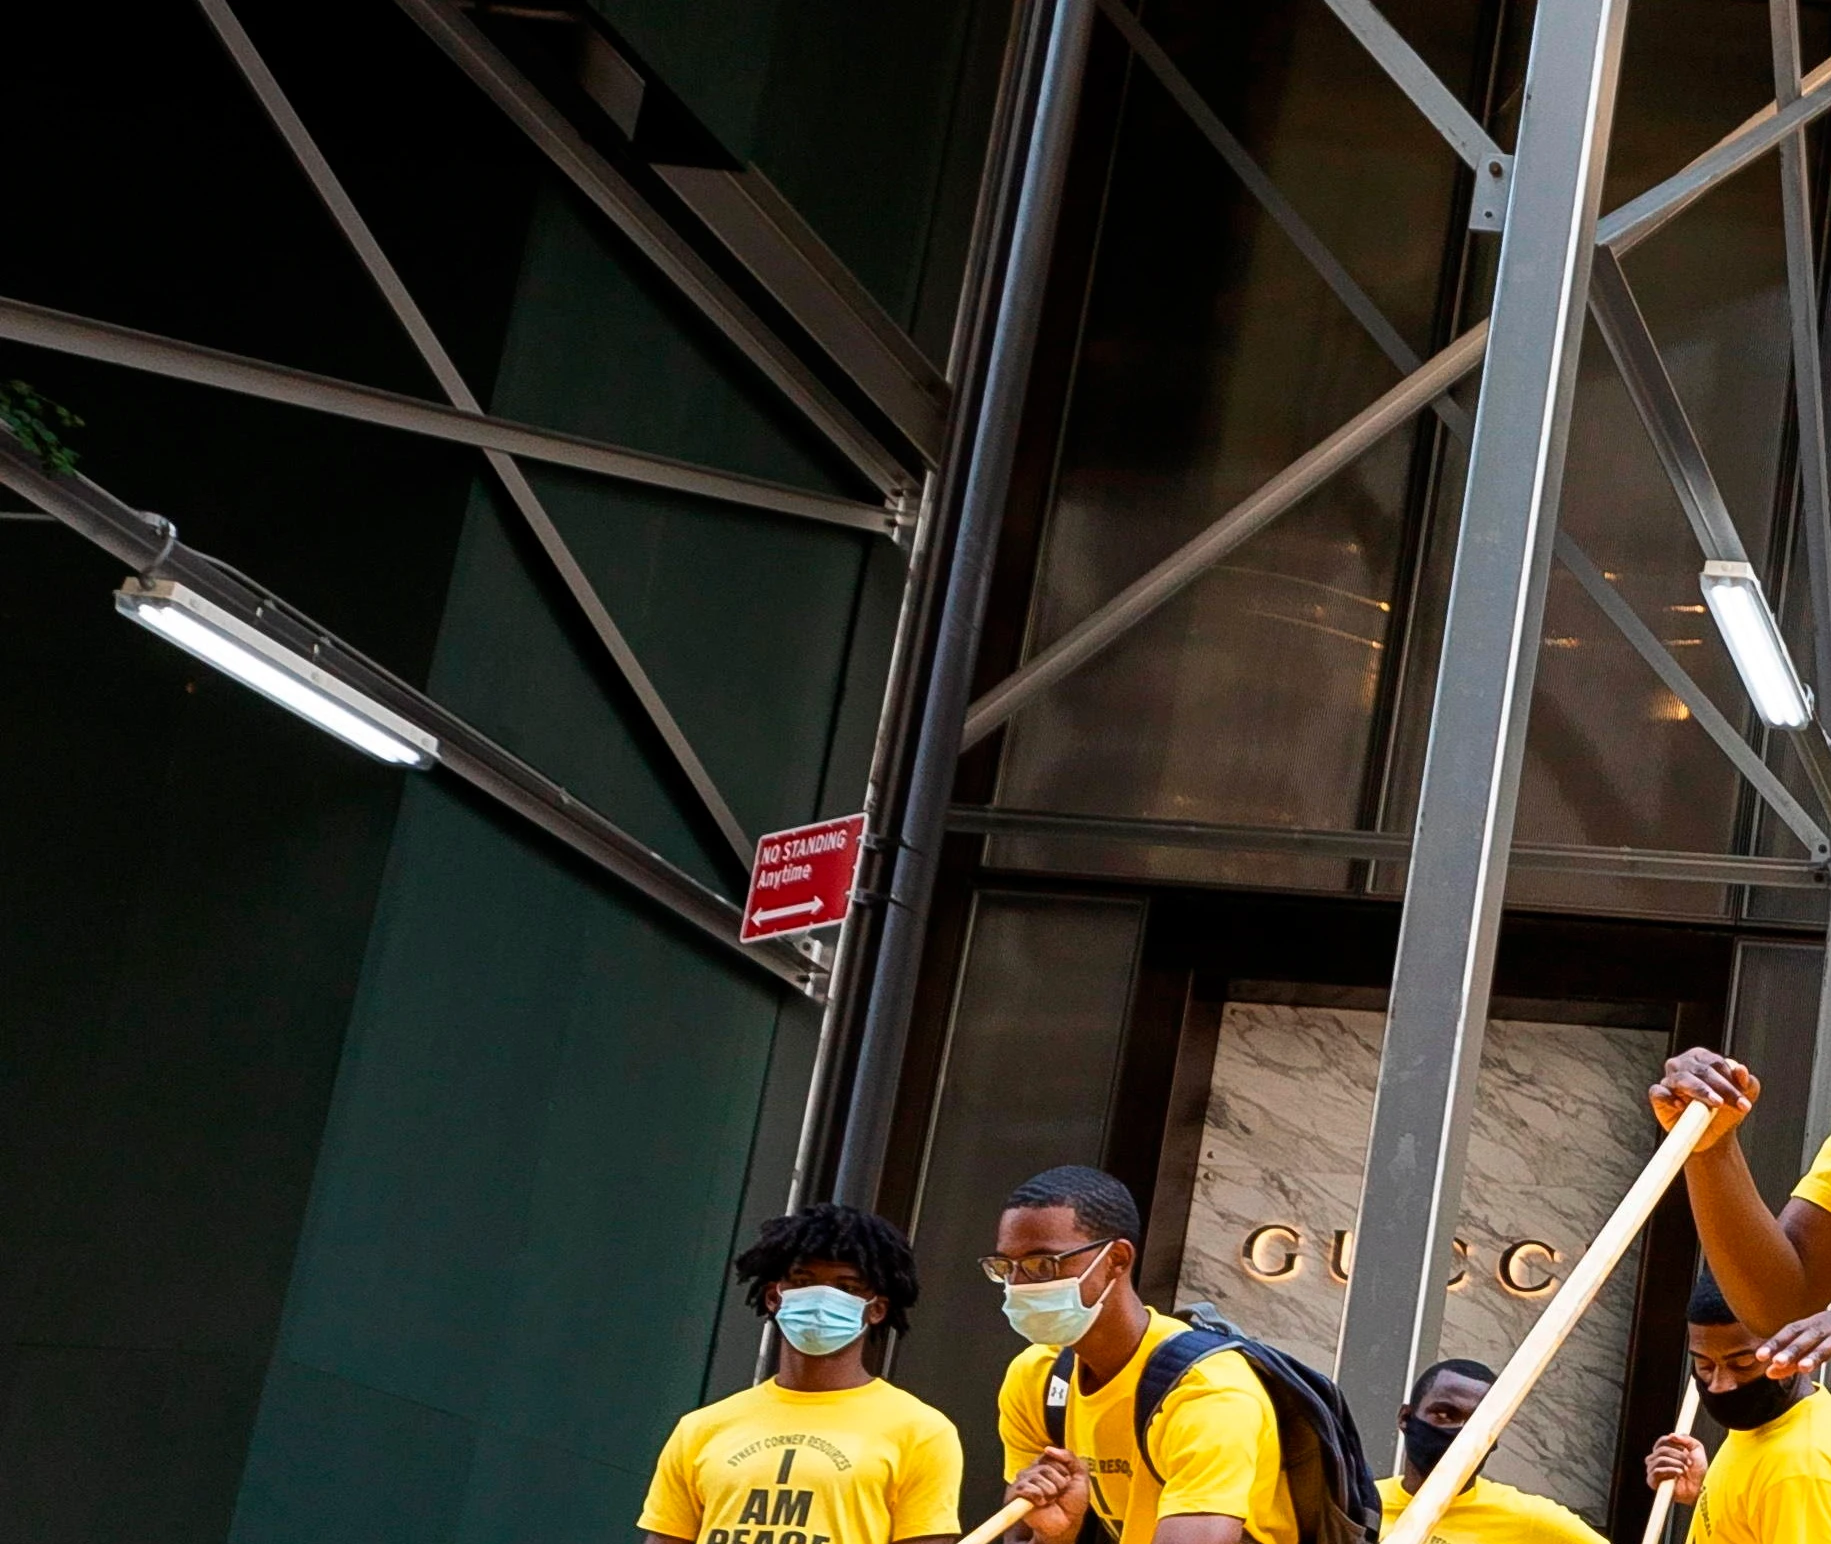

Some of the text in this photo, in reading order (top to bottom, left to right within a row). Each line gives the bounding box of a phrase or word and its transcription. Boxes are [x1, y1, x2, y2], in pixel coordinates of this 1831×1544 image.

[761, 829, 848, 865] NO STANDING
[756, 863, 813, 890] Anytime
[727, 1434, 852, 1472] STREET CORNER RESOURCES
[776, 1449, 796, 1485] I
[738, 1488, 814, 1527] AM
